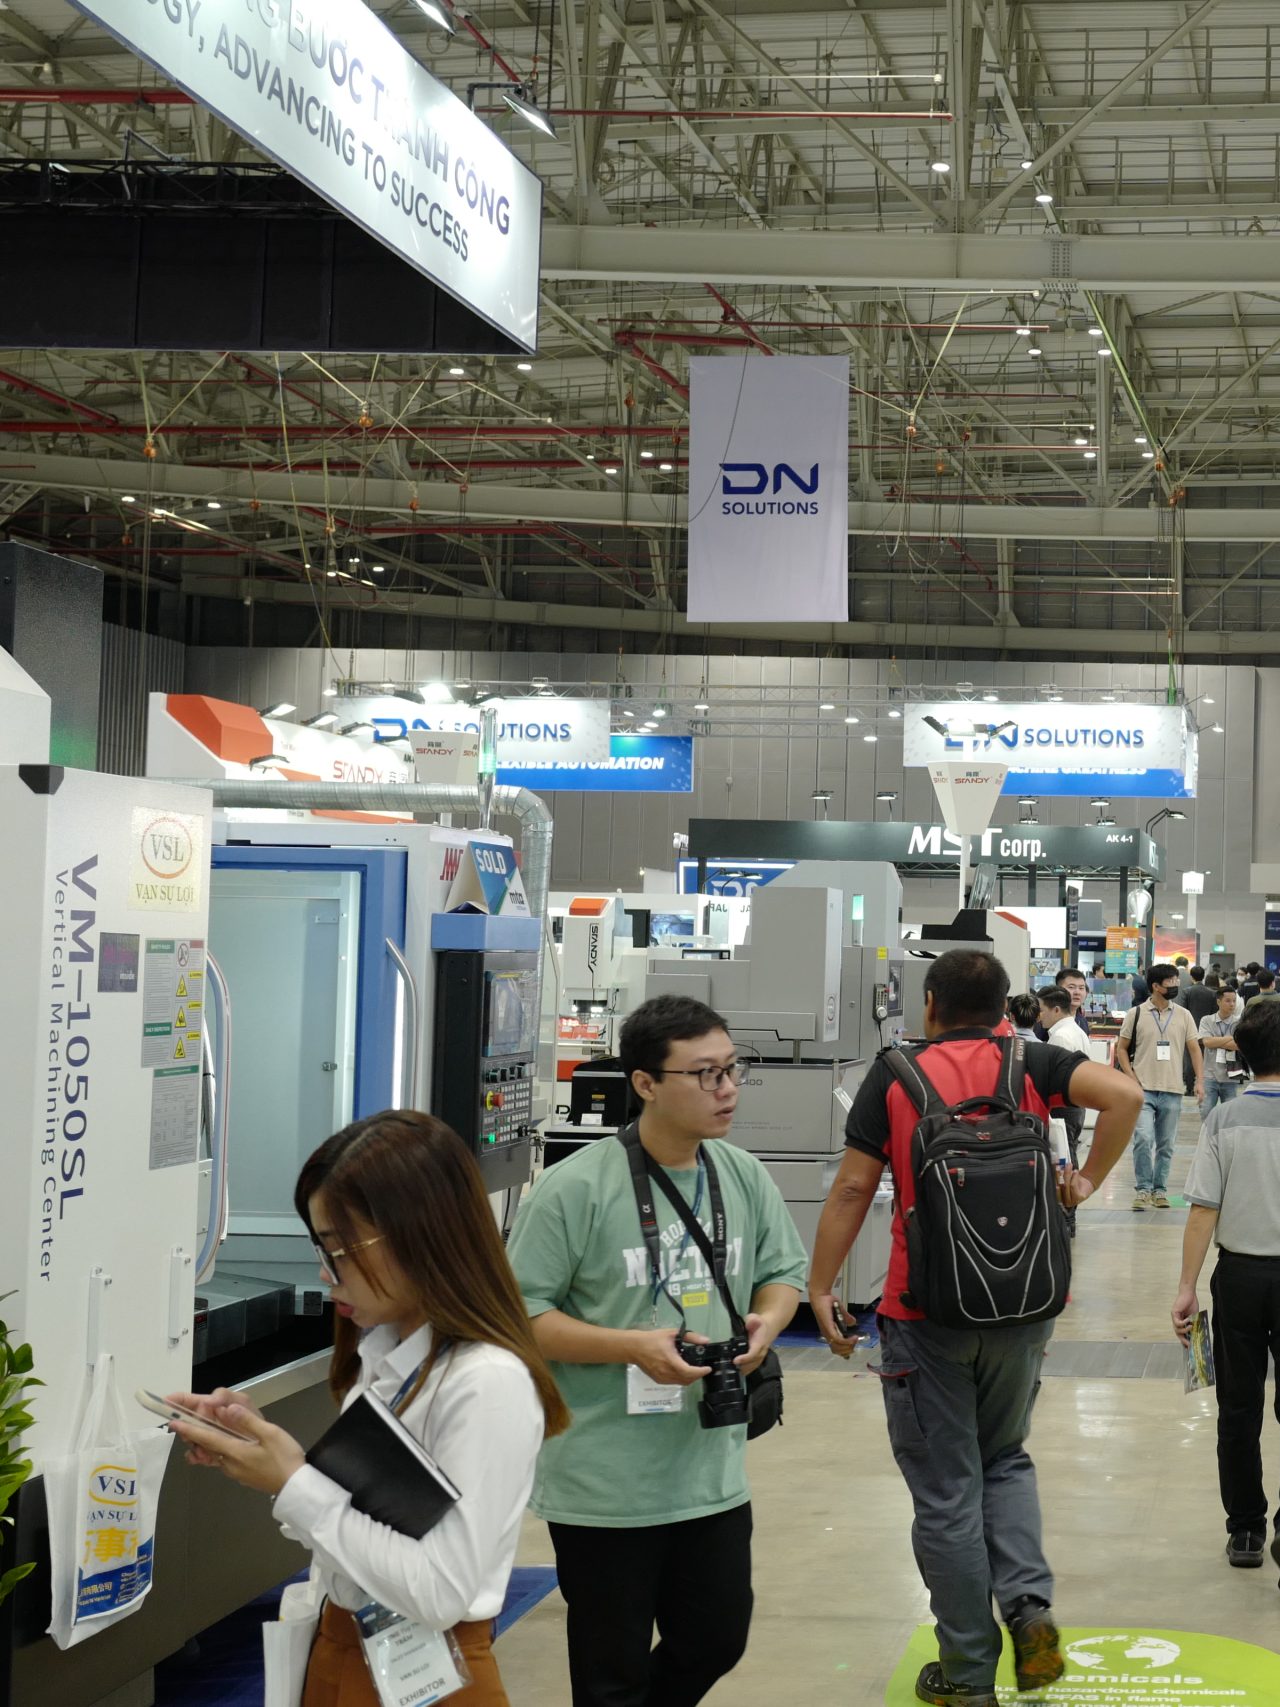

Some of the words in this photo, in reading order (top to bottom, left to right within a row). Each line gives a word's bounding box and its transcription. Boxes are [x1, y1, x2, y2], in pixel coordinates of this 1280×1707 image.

[214, 23, 356, 167] ADVANCING
[361, 141, 387, 192] TO
[390, 171, 469, 262] SUCCESS
[719, 463, 819, 495] DN
[722, 502, 819, 515] SOLUTIONS
[1024, 728, 1144, 746] SOLUTIONS
[415, 748, 454, 756] STANDY
[954, 777, 991, 785] STANDY
[150, 834, 184, 862] VSL
[908, 826, 1002, 857] MST
[1000, 837, 1047, 858] corp.
[1106, 834, 1119, 843] AK
[1120, 834, 1133, 843] 4-1
[476, 849, 507, 875] SOLD
[136, 884, 158, 903] VẠN
[51, 869, 68, 990] Vertical
[591, 925, 599, 967] STANDY
[60, 854, 98, 1220] VM-1050SL
[41, 1003, 63, 1166] Machining
[40, 1176, 57, 1282] Center
[716, 1213, 724, 1240] SONY
[400, 1678, 446, 1706] EXHIBITOR
[1057, 1673, 1203, 1684] emicals
[1045, 1693, 1100, 1701] PFAS
[1127, 1695, 1181, 1703] flame
